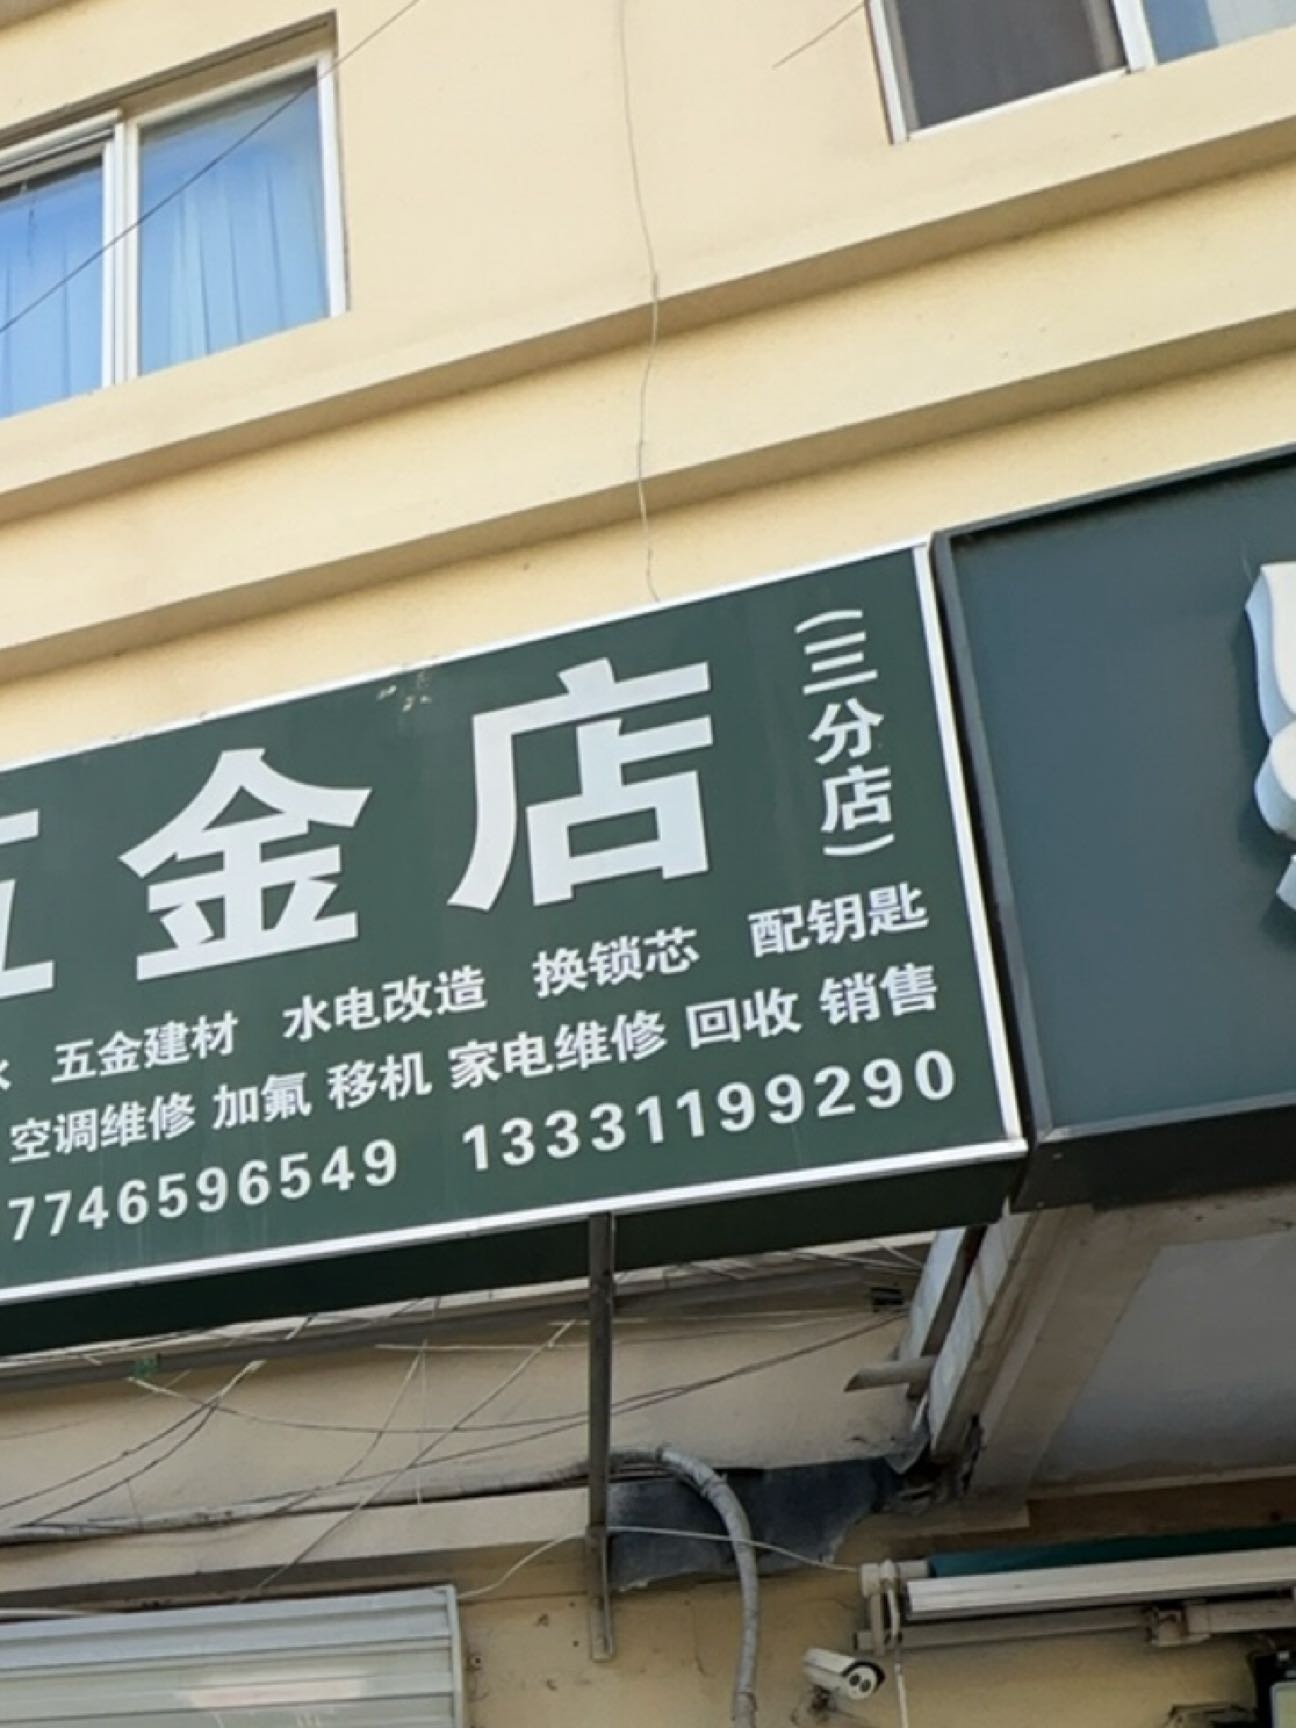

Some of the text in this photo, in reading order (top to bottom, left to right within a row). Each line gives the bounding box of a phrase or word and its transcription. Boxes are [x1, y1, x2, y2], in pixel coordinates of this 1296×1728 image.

[9, 1091, 196, 1164] 空调维修
[212, 1072, 311, 1130] 加氟
[327, 1051, 432, 1110] 移机
[448, 1008, 668, 1090] 家电维修
[685, 987, 802, 1050] 回收
[820, 962, 938, 1027] 销售
[51, 1010, 239, 1083] 五金建材
[282, 965, 488, 1042] 水电改造
[532, 926, 700, 999] 换锁芯
[747, 881, 930, 958] 配钥匙
[461, 1049, 956, 1172] 13331199290
